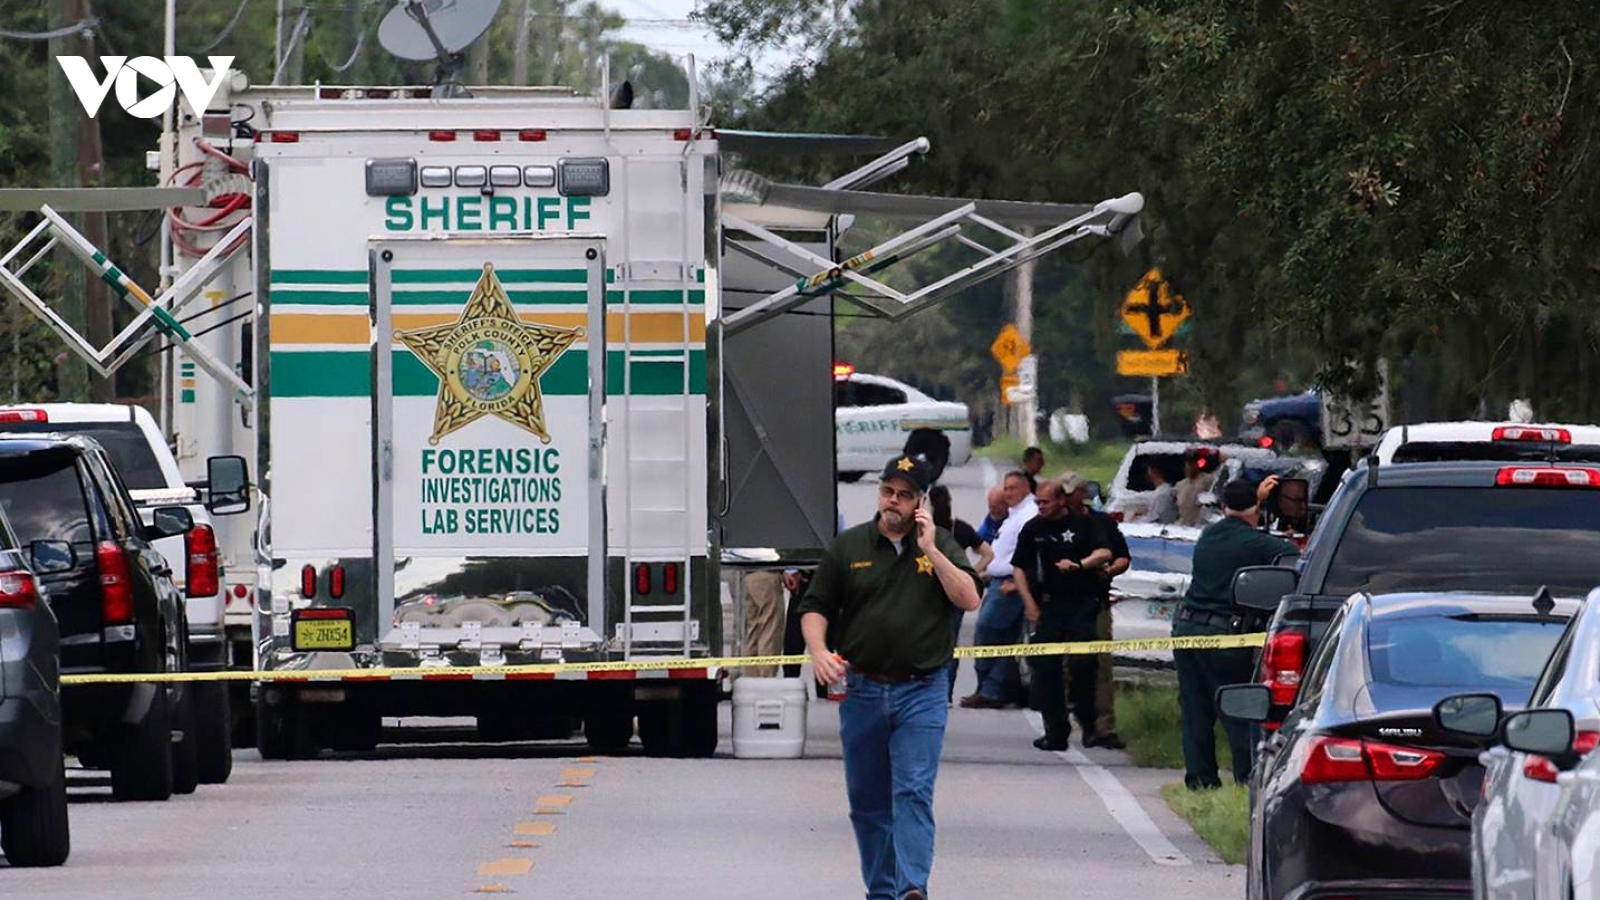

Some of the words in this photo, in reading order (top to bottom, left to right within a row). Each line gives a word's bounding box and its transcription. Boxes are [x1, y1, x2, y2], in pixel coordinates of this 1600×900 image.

[385, 196, 591, 231] SHERIFF
[443, 318, 497, 349] SHERIFF'S
[502, 321, 535, 348] OFFICE
[454, 333, 481, 354] POLK
[484, 330, 526, 357] COUNTY
[465, 394, 516, 412] FLORIDA
[421, 448, 560, 474] FORENSIC
[422, 477, 561, 503] INVESTIGATIONS
[422, 508, 458, 534] LAB
[465, 508, 559, 534] SERVICES
